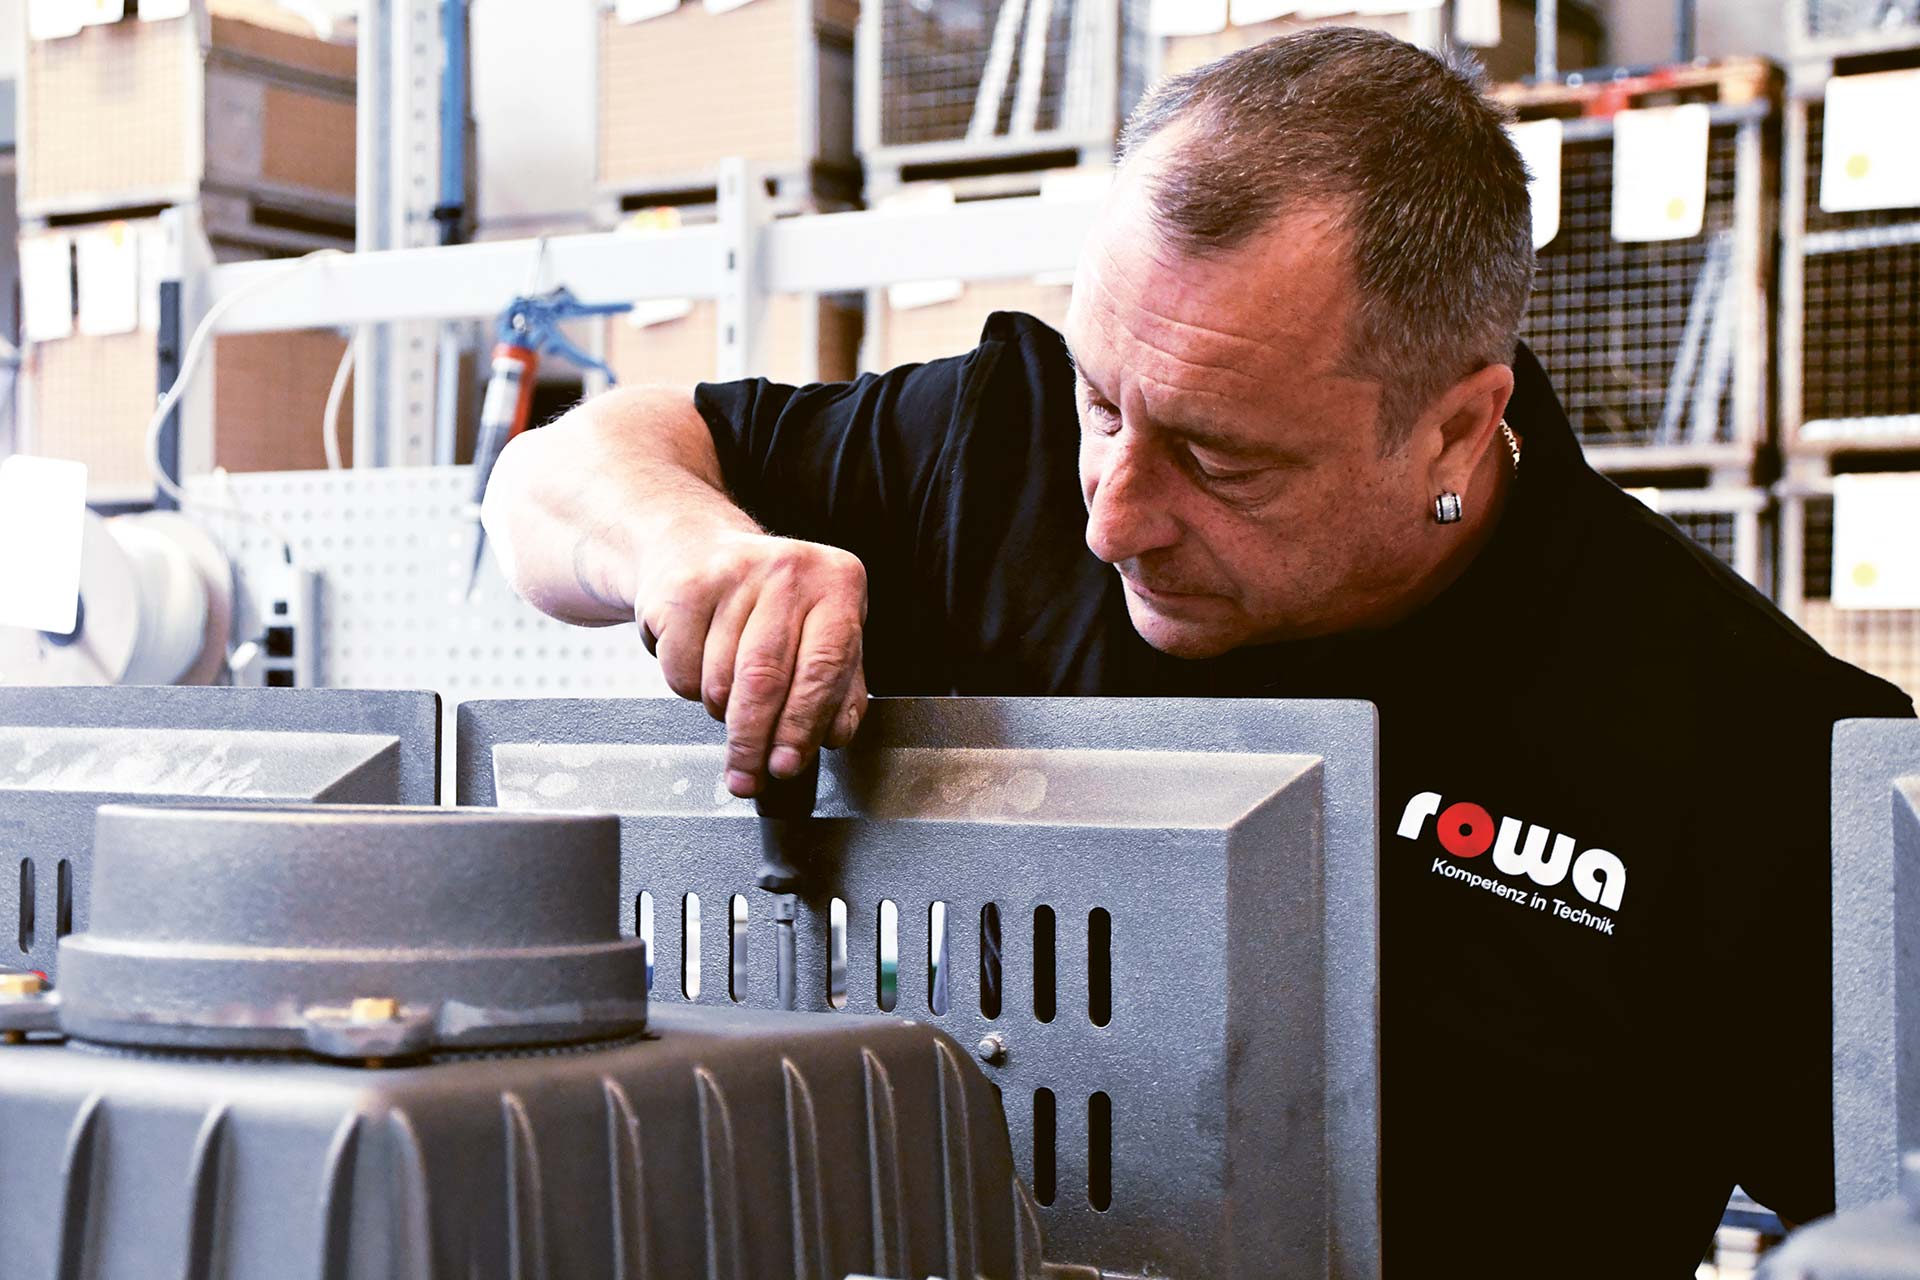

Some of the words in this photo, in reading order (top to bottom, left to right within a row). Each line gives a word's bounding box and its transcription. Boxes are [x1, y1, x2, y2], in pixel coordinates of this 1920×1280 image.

[1397, 791, 1626, 911] rowa
[1431, 857, 1528, 904] Kompetenz
[1530, 892, 1547, 911] in
[1552, 898, 1615, 935] Technik
